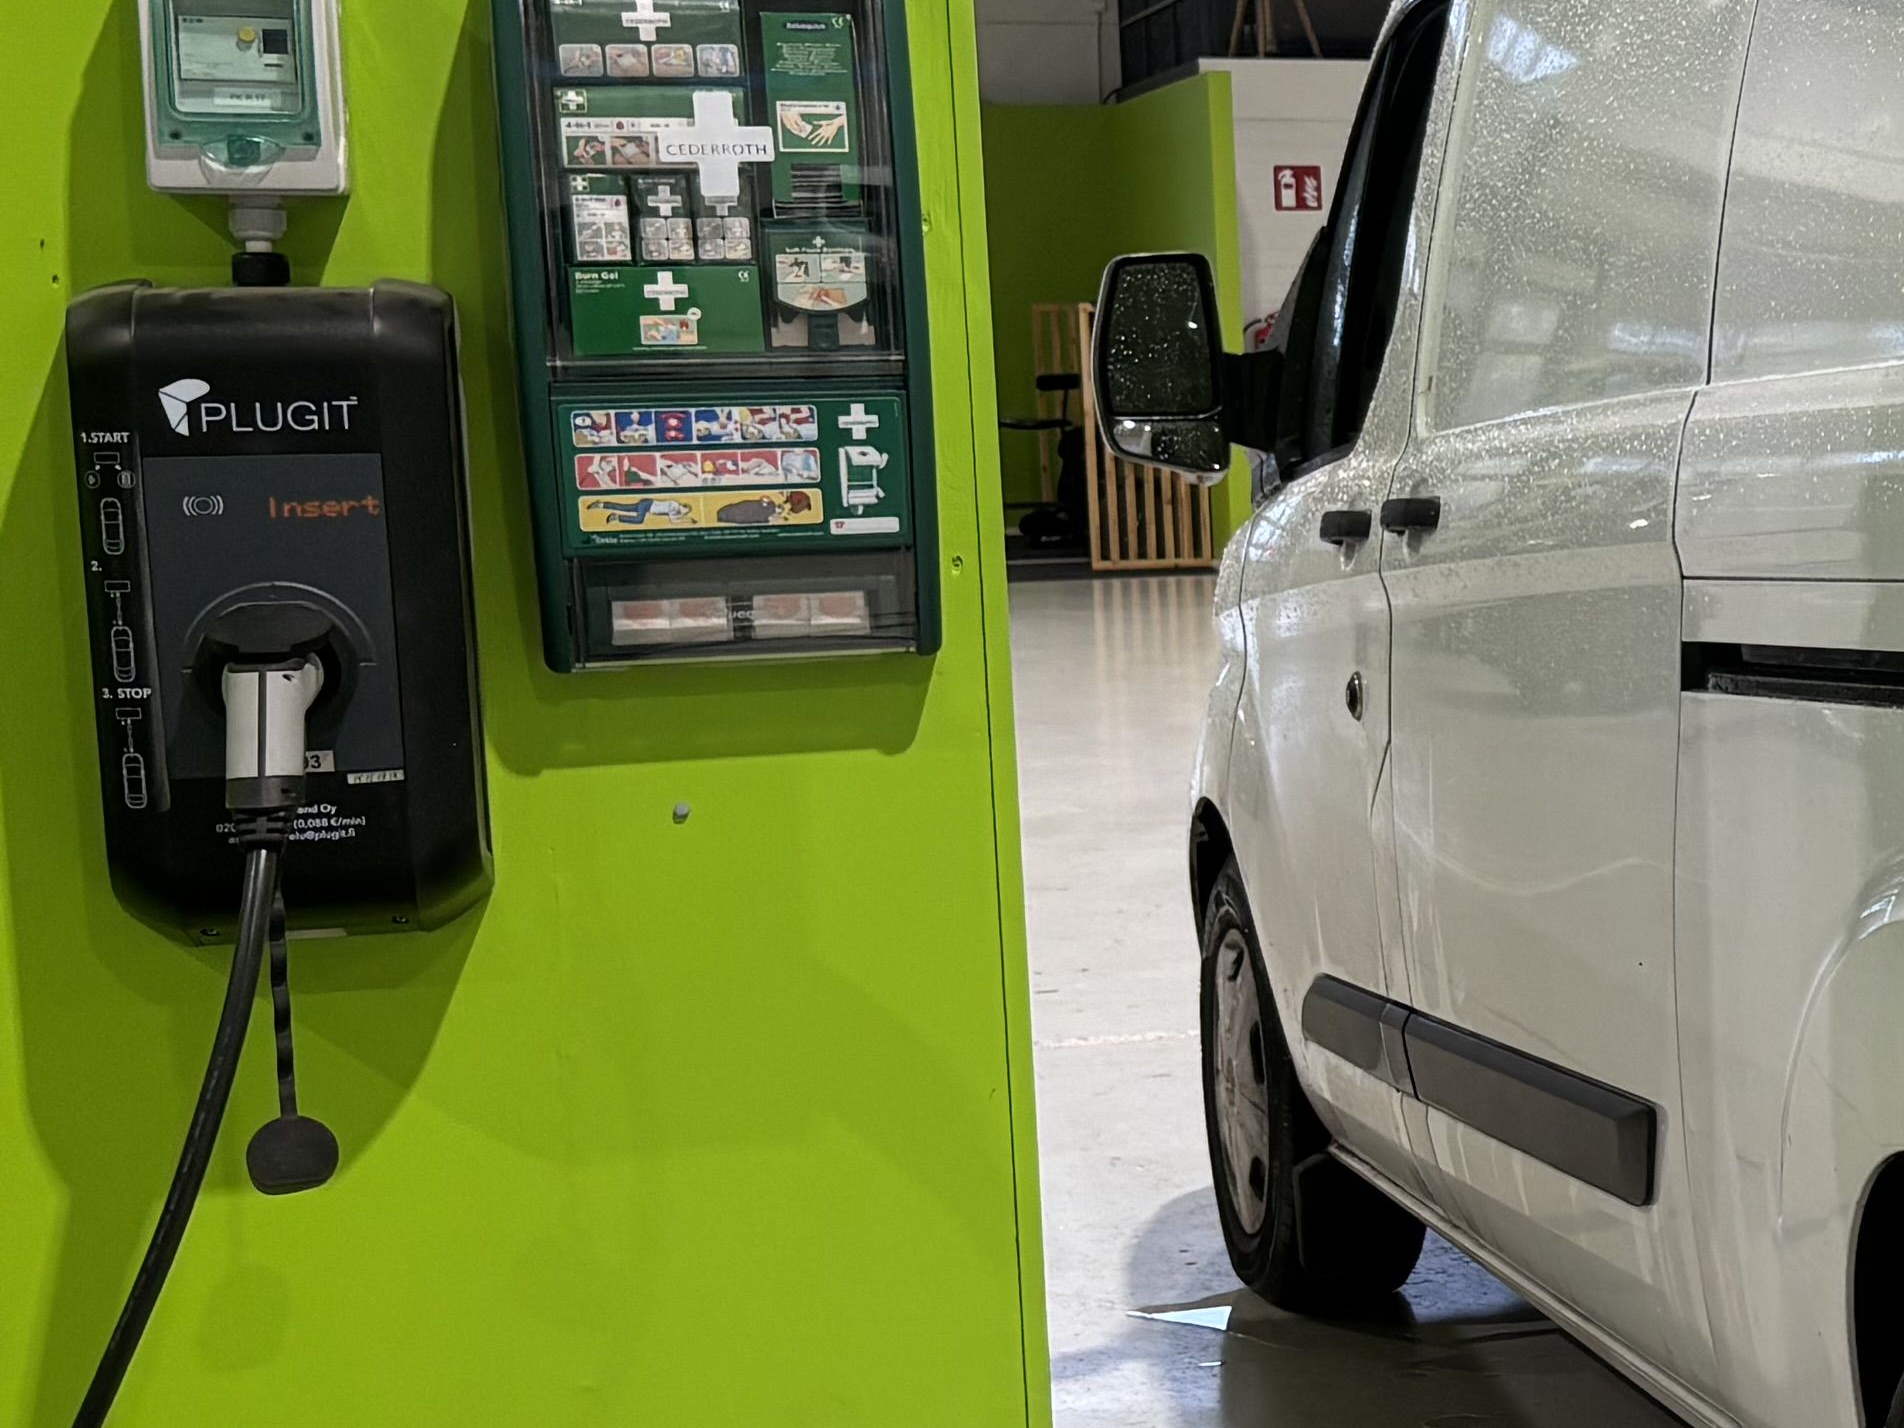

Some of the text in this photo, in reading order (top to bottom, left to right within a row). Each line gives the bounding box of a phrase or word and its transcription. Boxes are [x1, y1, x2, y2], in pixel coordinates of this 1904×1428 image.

[665, 143, 768, 156] CEDERROTH
[199, 400, 358, 433] PLUGIT
[80, 431, 130, 444] 1.START
[268, 495, 381, 519] Insert
[90, 560, 103, 572] 2.
[117, 687, 152, 700] STOP
